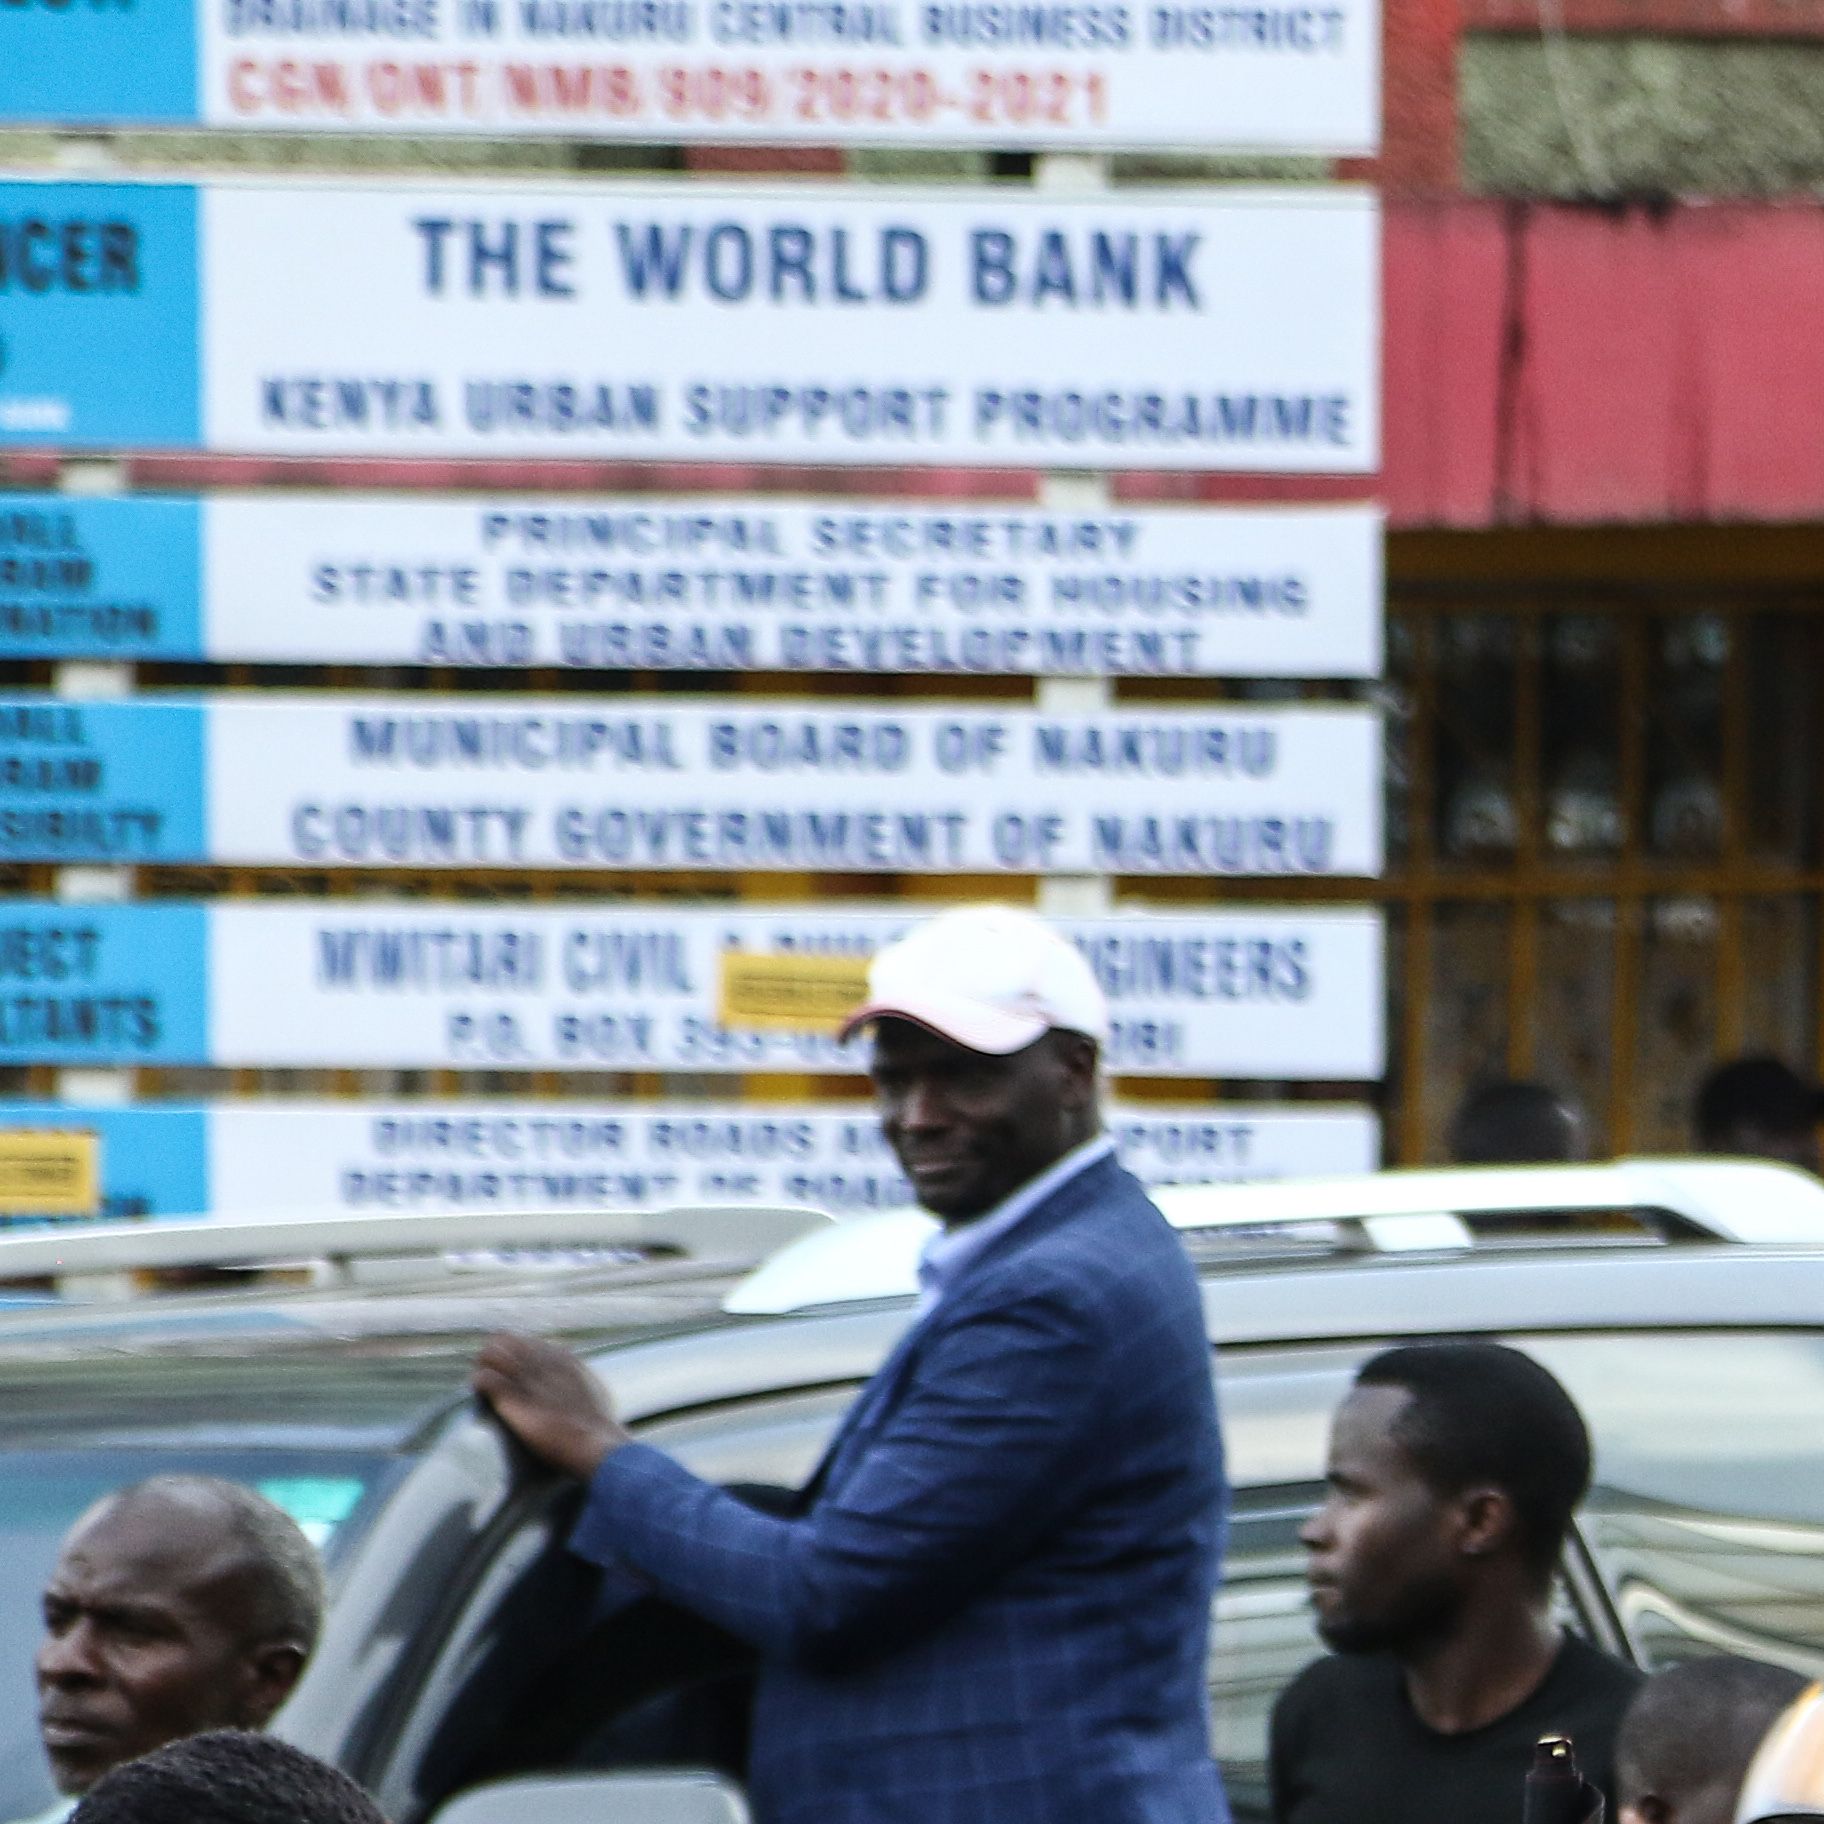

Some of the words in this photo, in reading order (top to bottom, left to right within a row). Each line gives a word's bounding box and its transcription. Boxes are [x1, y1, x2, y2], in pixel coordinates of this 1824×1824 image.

[518, 0, 692, 44] NAKURU
[708, 0, 900, 48] CENTRAL
[921, 4, 1130, 50] BUSINESS
[1150, 8, 1345, 55] DISTRICT
[411, 219, 577, 300] THE
[615, 222, 931, 305] WORLD
[972, 227, 1206, 311] BANK
[261, 376, 440, 434] KENYA
[466, 381, 662, 438] URBAN
[686, 385, 950, 443] SUPPORT
[977, 391, 1353, 447] PROGRAMME
[481, 512, 789, 556] PRINCIPAL
[811, 516, 1140, 562] SECRETARY
[311, 564, 478, 607] STATE
[505, 567, 892, 613] DEPARTMENT
[915, 571, 1025, 614] FOR
[1053, 574, 1309, 619] HOUSING
[419, 620, 537, 668] AND
[563, 622, 754, 670] URBAN
[781, 625, 1202, 675] DEVELOPMENT
[349, 715, 682, 772] MUNICIPAL
[708, 718, 905, 774] BOARD
[932, 720, 1006, 775] OF
[1033, 722, 1277, 777] NAKURU
[291, 805, 529, 863] COUNTY
[555, 807, 965, 868] GOVERNMENT
[991, 812, 1066, 870] OF
[1092, 815, 1333, 874] NAKURU
[563, 929, 694, 999] CIVIL
[557, 1012, 649, 1062] BOX
[372, 1116, 626, 1159] DIRECTOR
[650, 1118, 813, 1160] ROADS
[341, 1171, 680, 1205] DEPARTMENT
